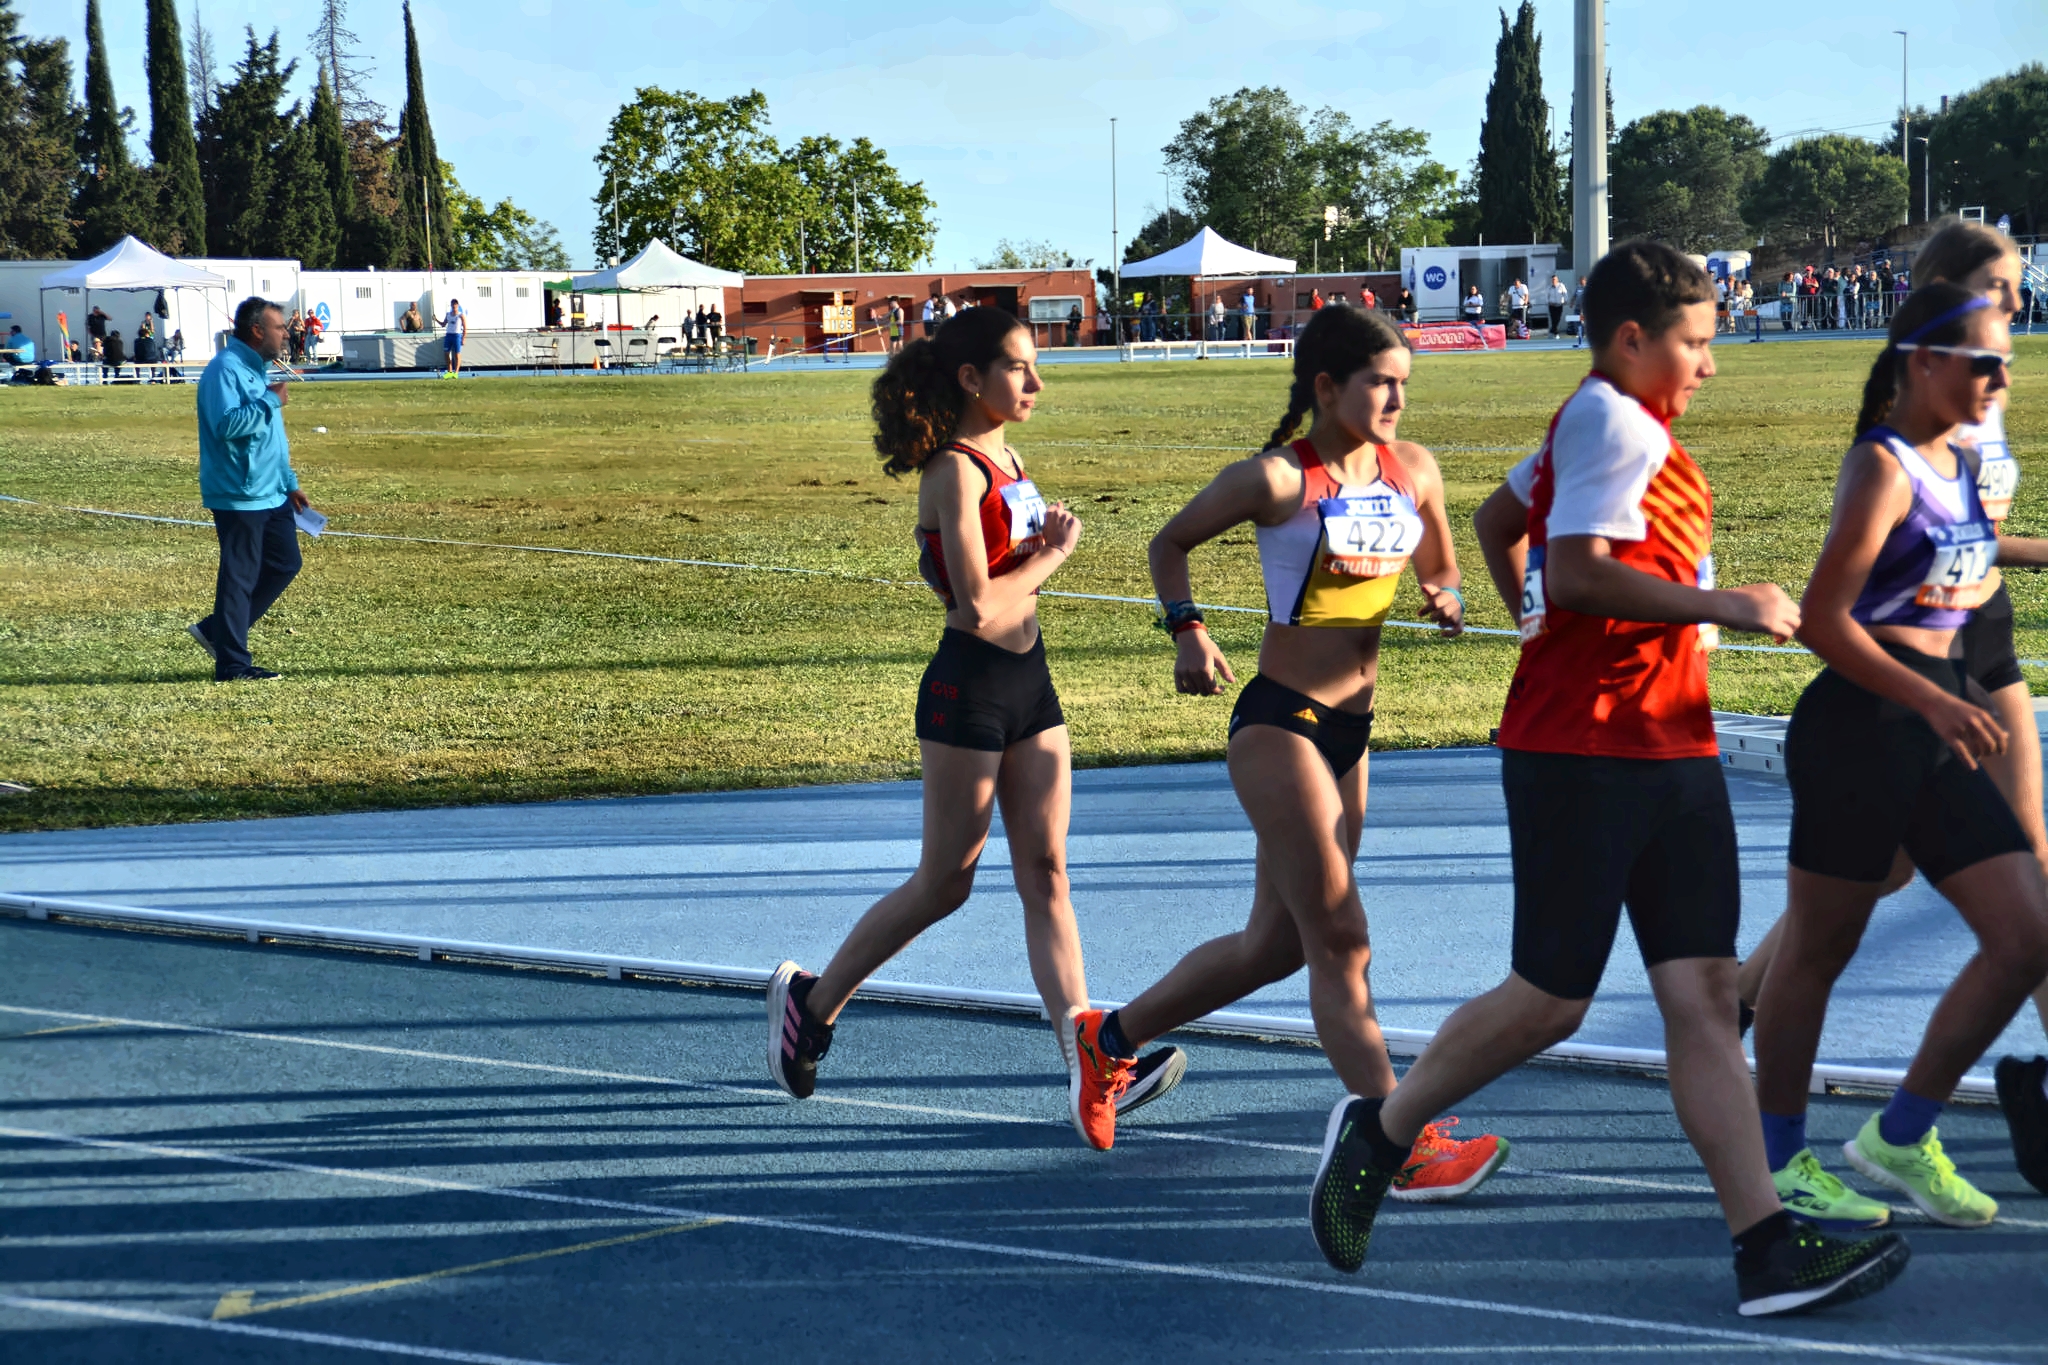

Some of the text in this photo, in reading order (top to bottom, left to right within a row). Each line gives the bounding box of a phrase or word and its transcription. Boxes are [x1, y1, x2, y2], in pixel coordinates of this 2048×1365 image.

[1426, 273, 1444, 282] WC
[840, 306, 852, 316] 46
[1346, 520, 1406, 553] 422
